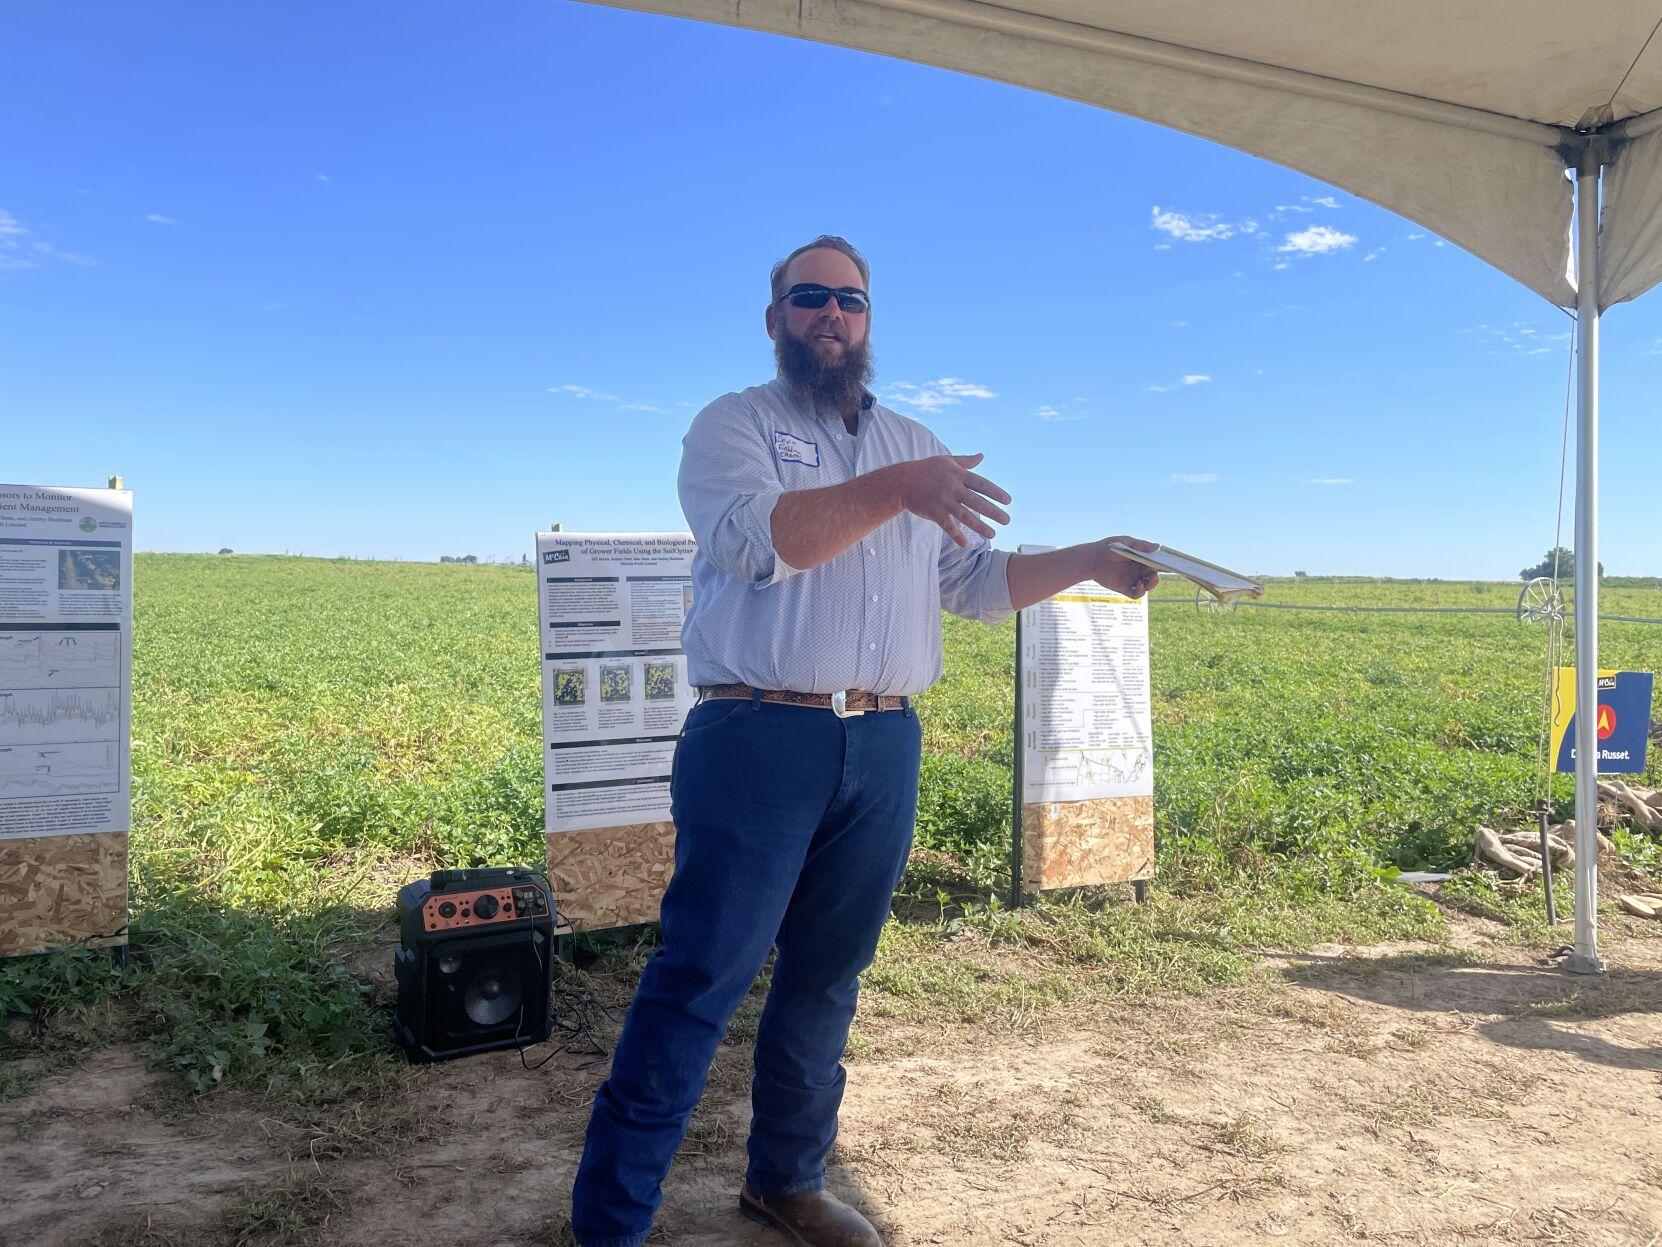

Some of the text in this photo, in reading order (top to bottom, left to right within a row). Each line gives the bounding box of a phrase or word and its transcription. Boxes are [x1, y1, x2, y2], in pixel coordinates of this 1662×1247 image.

[35, 492, 73, 501] Monitor
[20, 503, 80, 513] Management
[555, 539, 583, 548] Mapping
[584, 539, 612, 547] Physical,
[613, 539, 644, 547] Chemical,
[657, 539, 687, 548] Biological
[633, 548, 651, 556] Using
[545, 552, 569, 562] McCain
[1597, 679, 1615, 687] McCain
[1602, 749, 1630, 760] Russet.
